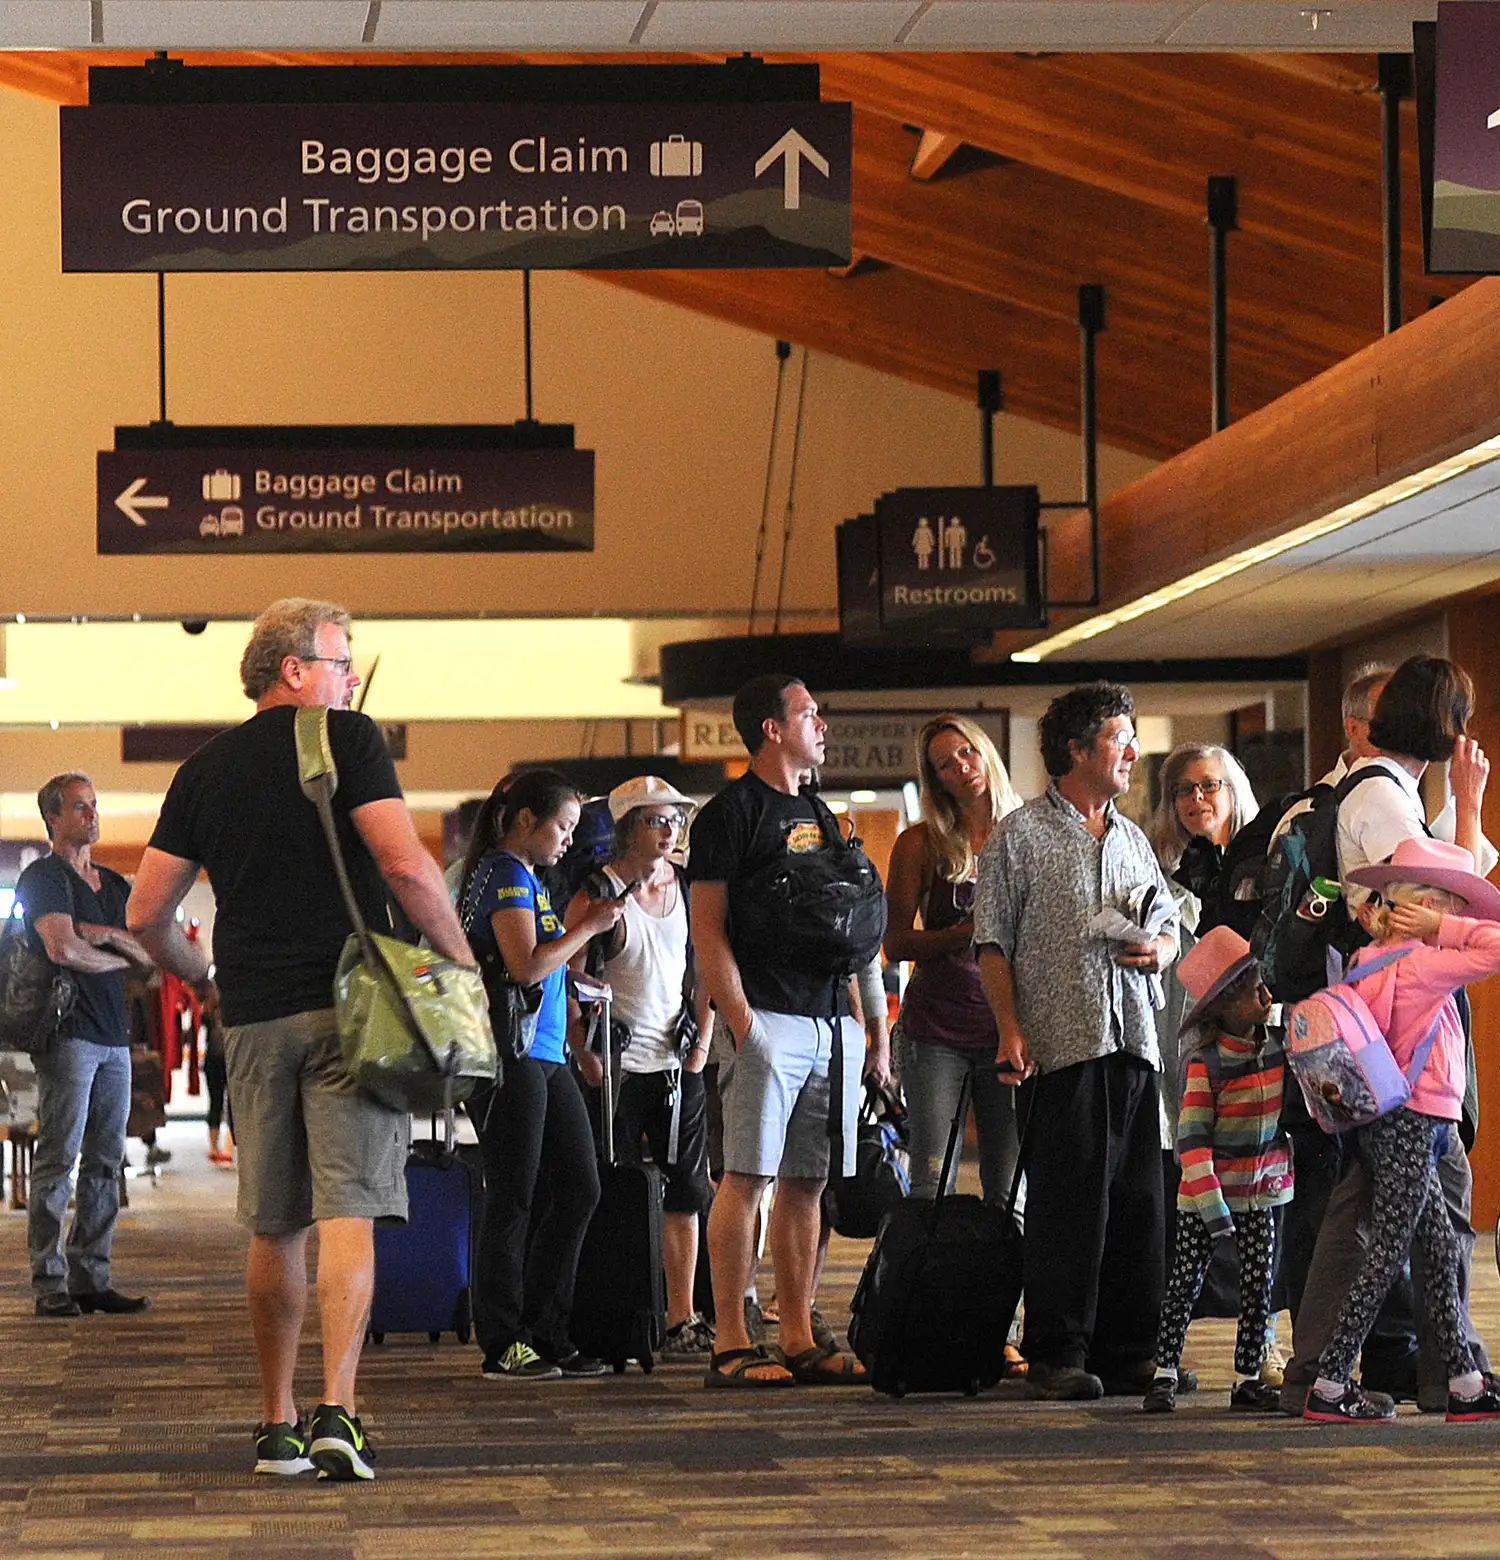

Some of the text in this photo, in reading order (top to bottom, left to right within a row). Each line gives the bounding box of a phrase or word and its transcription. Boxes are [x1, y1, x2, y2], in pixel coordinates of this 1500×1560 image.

[301, 138, 628, 184] Baggage Claim
[121, 196, 627, 240] Ground Transportation
[255, 467, 464, 498] Baggage Claim
[256, 504, 574, 534] Ground Transportation
[893, 584, 1017, 605] Restrooms
[823, 745, 903, 769] GRAB
